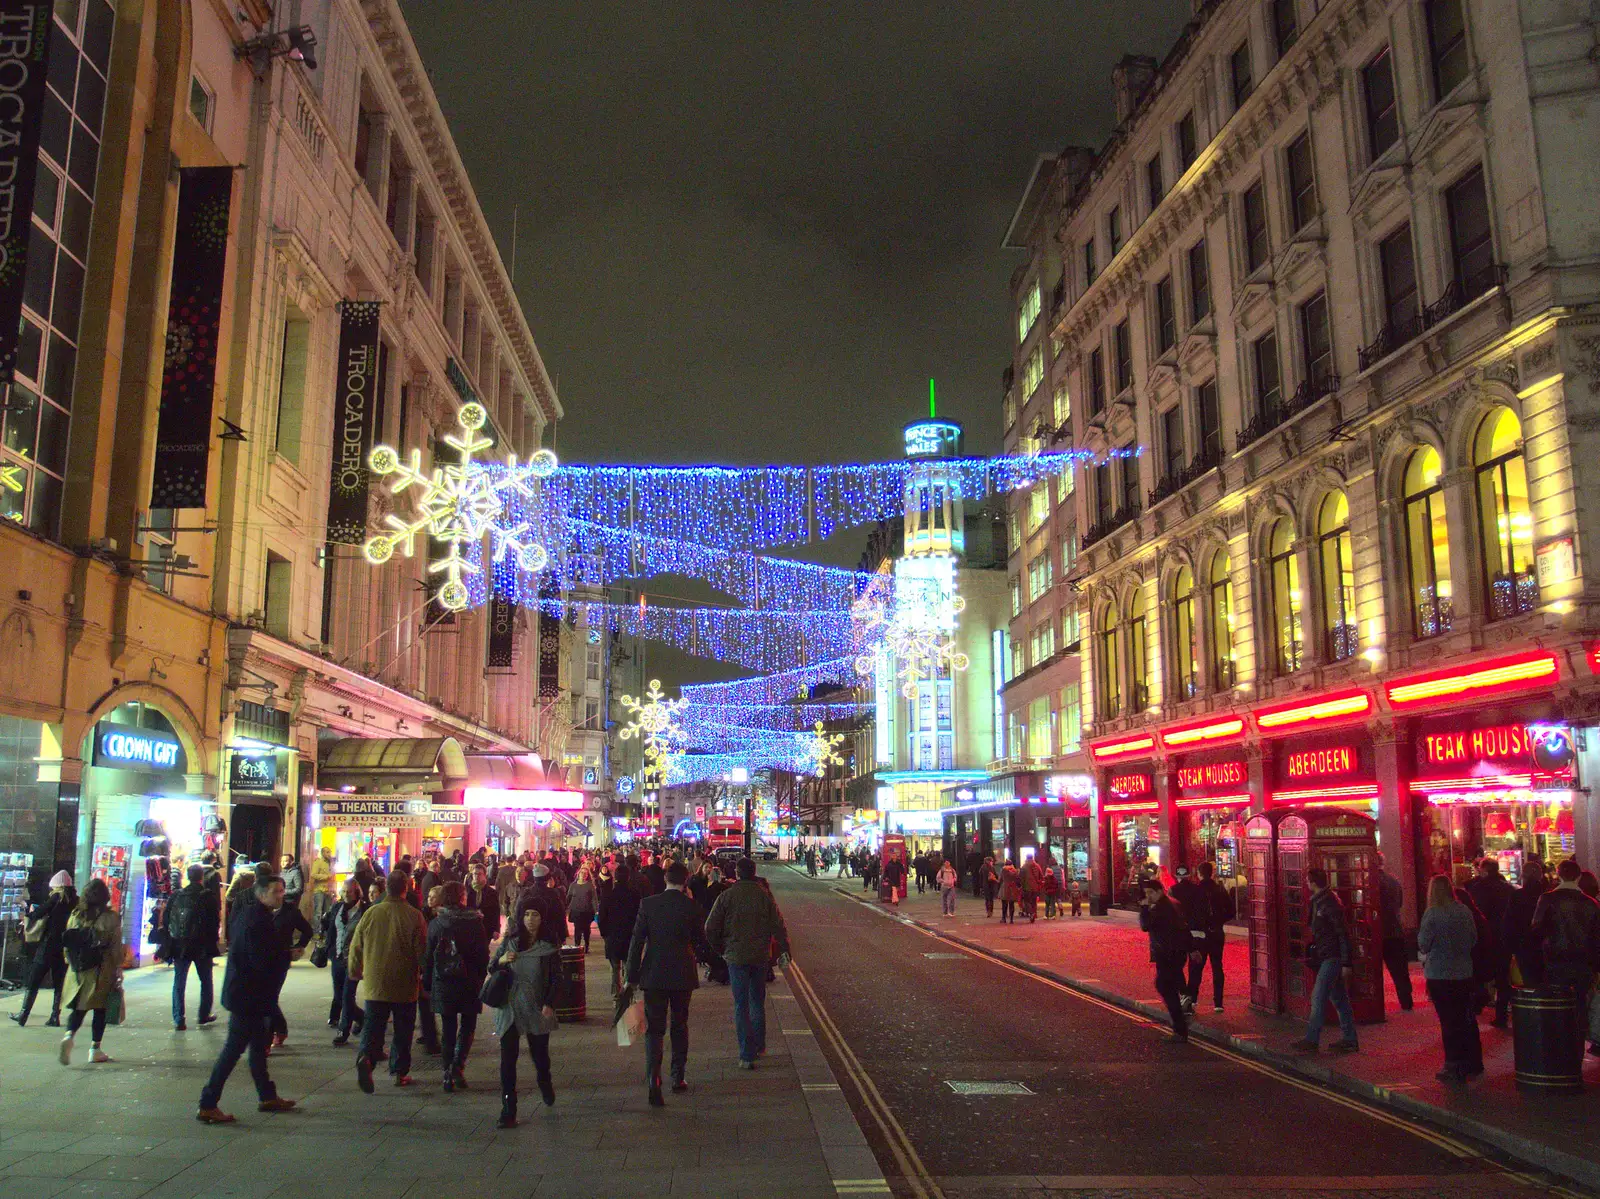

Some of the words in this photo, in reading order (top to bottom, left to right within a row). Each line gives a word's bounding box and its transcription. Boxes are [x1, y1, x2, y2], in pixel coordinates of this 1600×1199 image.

[341, 344, 368, 489] TROCADERO
[906, 441, 938, 455] WALES
[108, 735, 153, 762] CROWN
[154, 742, 179, 765] GIFT
[1289, 749, 1350, 777] ABERDEEN
[1178, 768, 1203, 788] STEAK
[1206, 762, 1241, 785] HOUSES
[340, 802, 385, 813] THEATRE
[387, 802, 428, 813] TICETS
[431, 811, 467, 822] TICKETS
